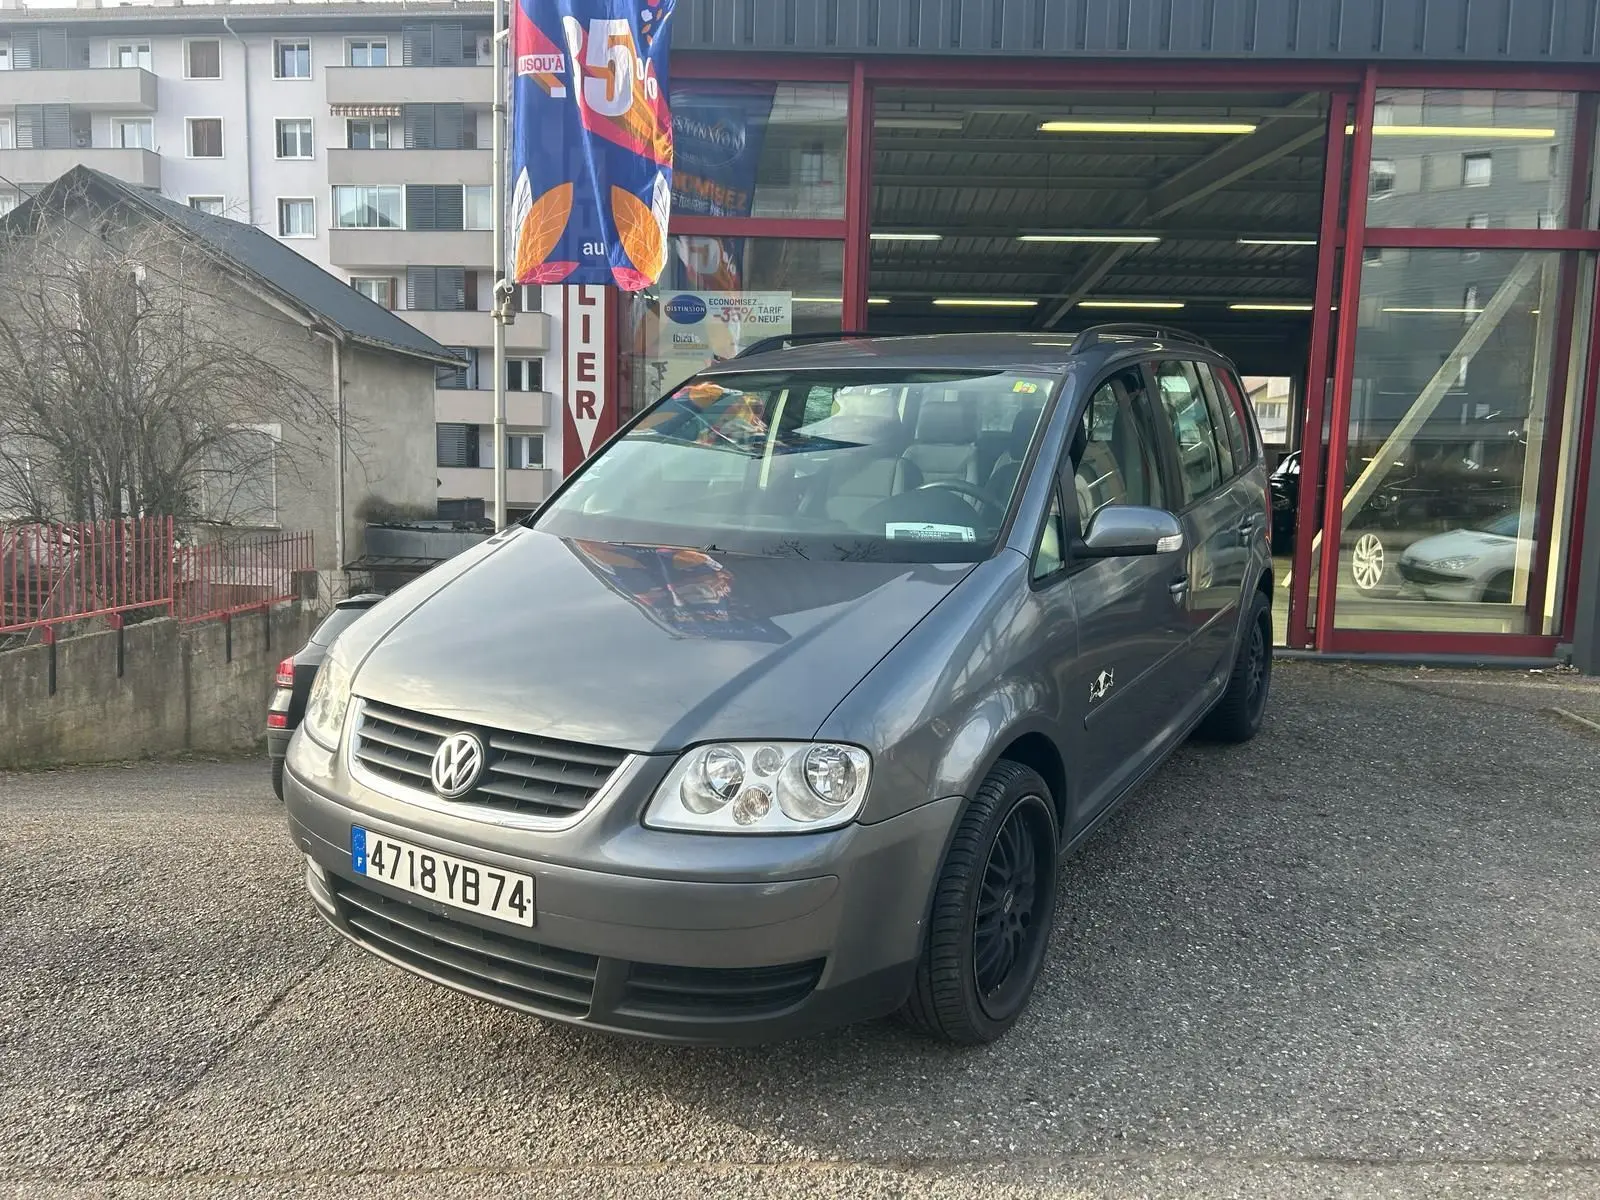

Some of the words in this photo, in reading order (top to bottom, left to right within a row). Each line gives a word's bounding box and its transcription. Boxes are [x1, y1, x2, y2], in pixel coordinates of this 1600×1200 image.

[520, 57, 563, 71] USQU'À
[583, 242, 605, 255] au
[758, 306, 783, 315] TARIF
[357, 856, 363, 867] F
